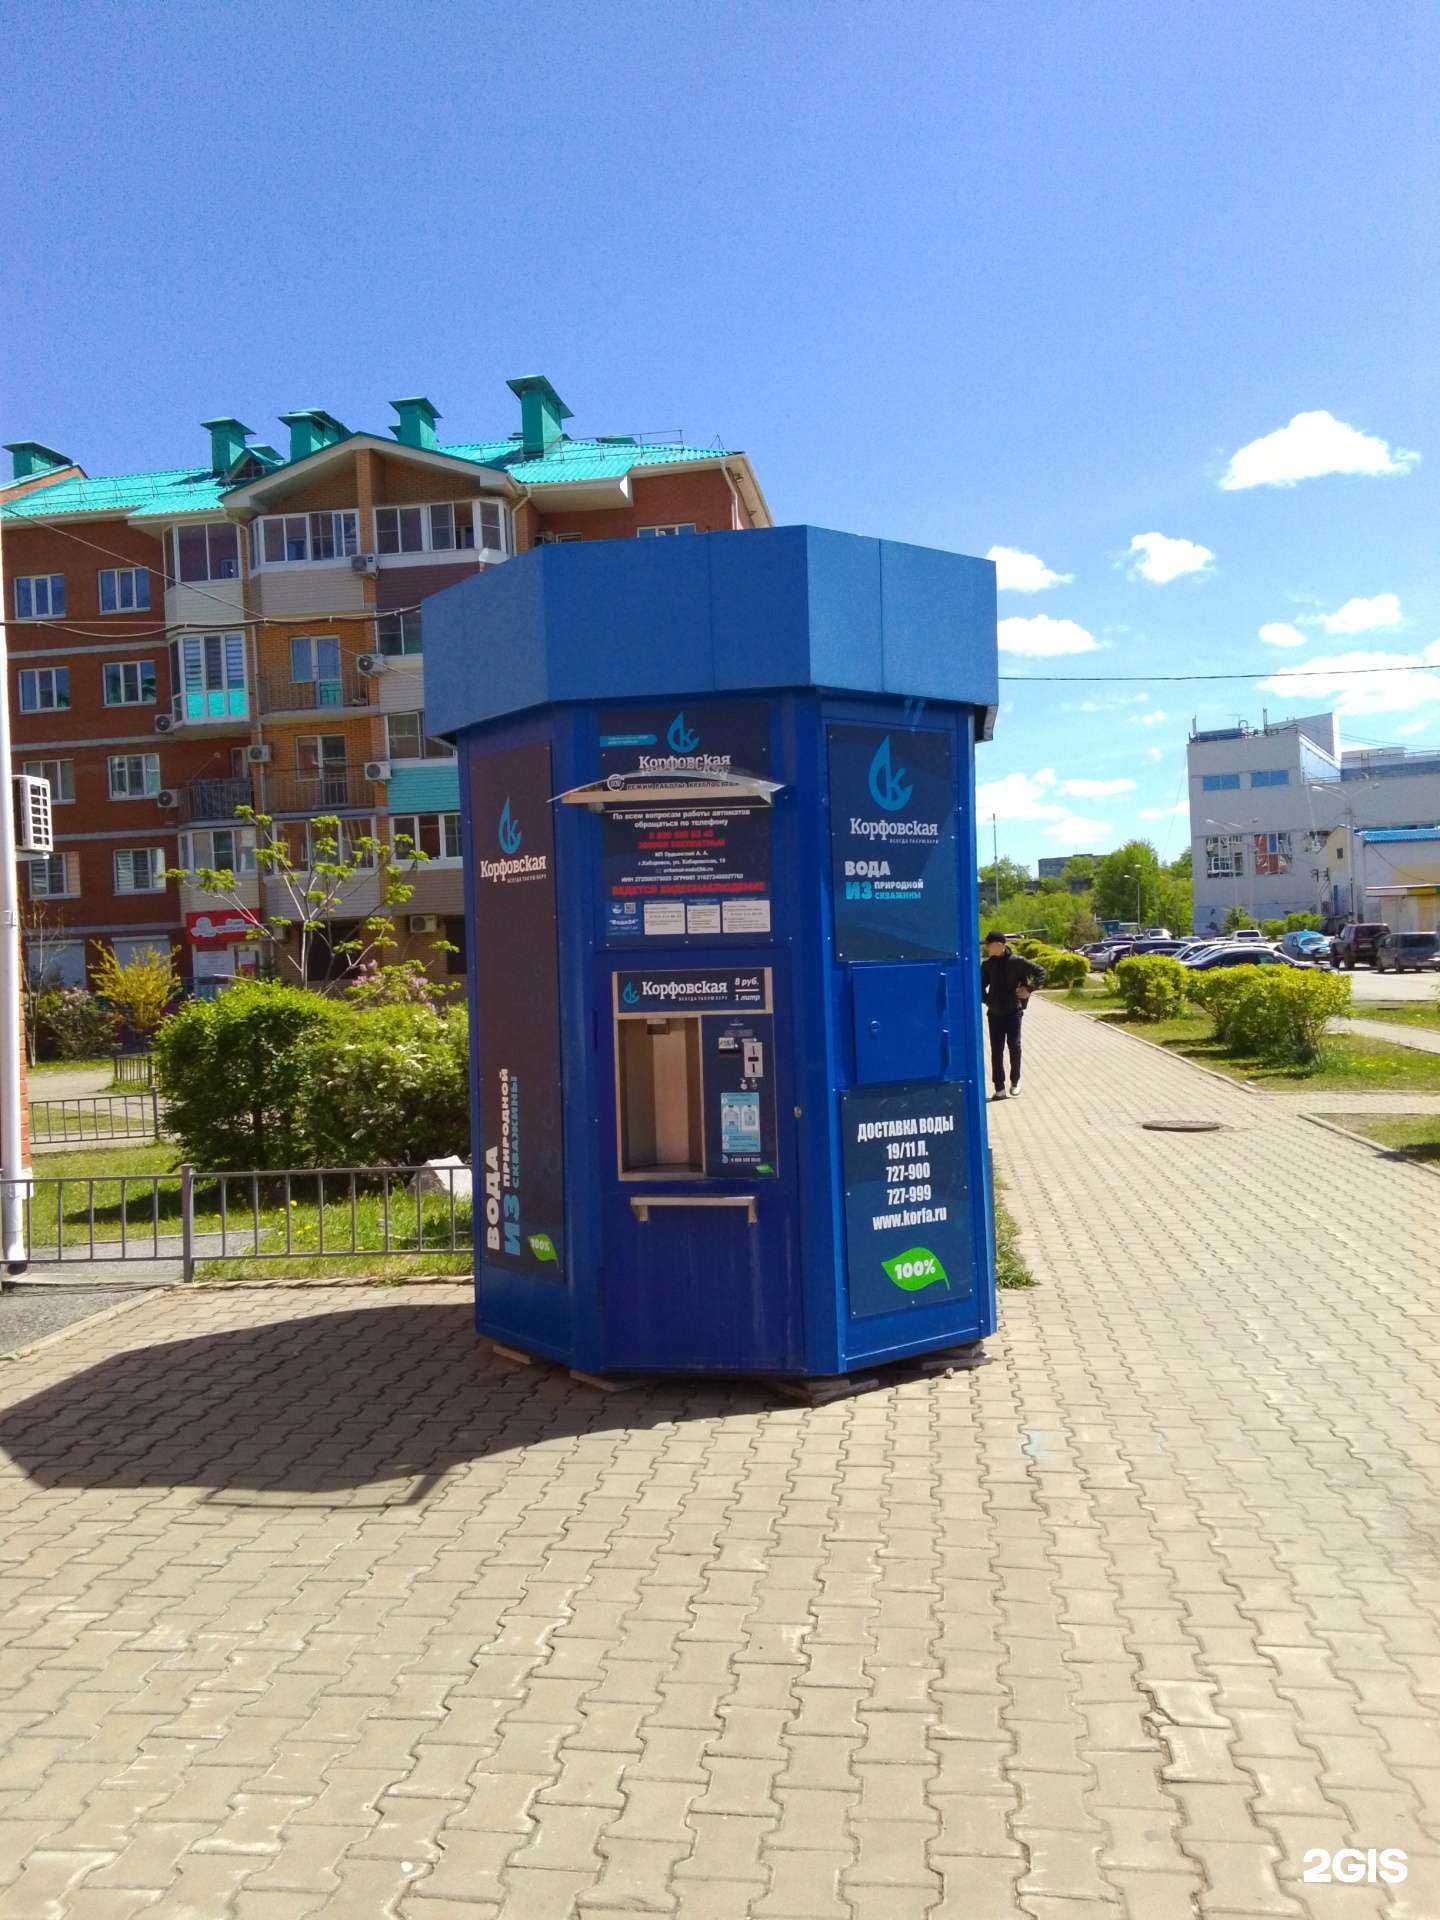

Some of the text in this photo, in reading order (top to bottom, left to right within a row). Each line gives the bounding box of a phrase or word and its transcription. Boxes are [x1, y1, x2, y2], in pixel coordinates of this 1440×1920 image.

[634, 820, 678, 829] обращаться
[692, 818, 728, 827] телефону
[645, 811, 681, 820] вопросам
[683, 810, 710, 819] работы
[850, 818, 938, 840] Корфовская
[480, 855, 547, 882] Корфовская
[844, 861, 891, 878] ВОДА
[845, 882, 872, 900] ИЗ
[874, 879, 924, 890] ПРИРОДНОЙ
[874, 891, 922, 900] СКВАЖИНЫ
[642, 980, 728, 1000] Корфовская
[741, 976, 760, 987] руб.
[500, 1068, 511, 1187] ПРИРОДНОЙ
[511, 1076, 520, 1189] СКВАЖИНЫ
[857, 1115, 954, 1143] ДОСТАВКА ВОДЫ
[886, 1141, 916, 1160] 19/11
[886, 1162, 931, 1182] 727-900
[485, 1146, 500, 1251] ВОДА
[887, 1184, 932, 1205] 727-999
[504, 1193, 521, 1256] ИЗ
[872, 1206, 948, 1231] www.korfa.ru
[530, 1237, 550, 1252] 100%
[894, 1258, 936, 1280] 100%
